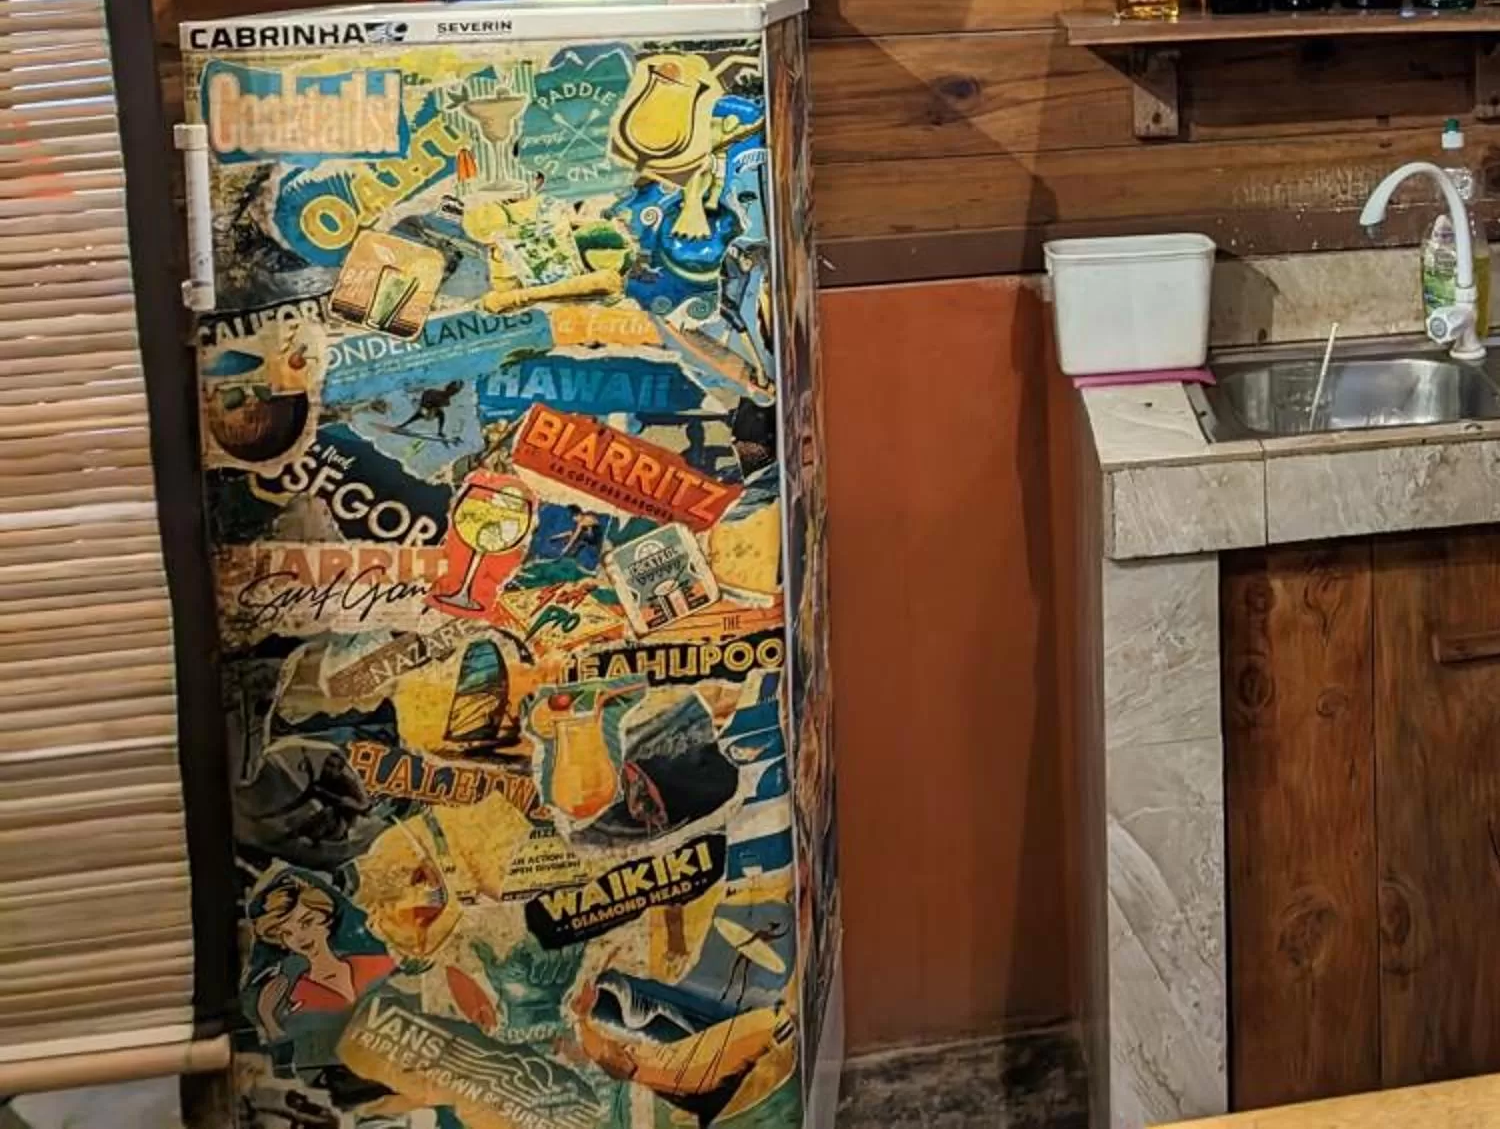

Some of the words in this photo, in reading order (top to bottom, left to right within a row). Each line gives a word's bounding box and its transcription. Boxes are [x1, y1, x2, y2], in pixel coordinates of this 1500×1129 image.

[190, 22, 366, 49] CABRINHA
[438, 20, 512, 33] SEVERIN
[536, 81, 619, 113] PADDLE
[525, 409, 729, 522] BIARRITZ
[722, 616, 742, 631] THE
[535, 840, 714, 921] WAIKIKI
[572, 894, 647, 930] DIAMOND
[650, 881, 692, 904] HEAD
[368, 996, 446, 1058] VANS
[352, 1032, 415, 1071] TRIPLE
[417, 1059, 484, 1102] CROWN
